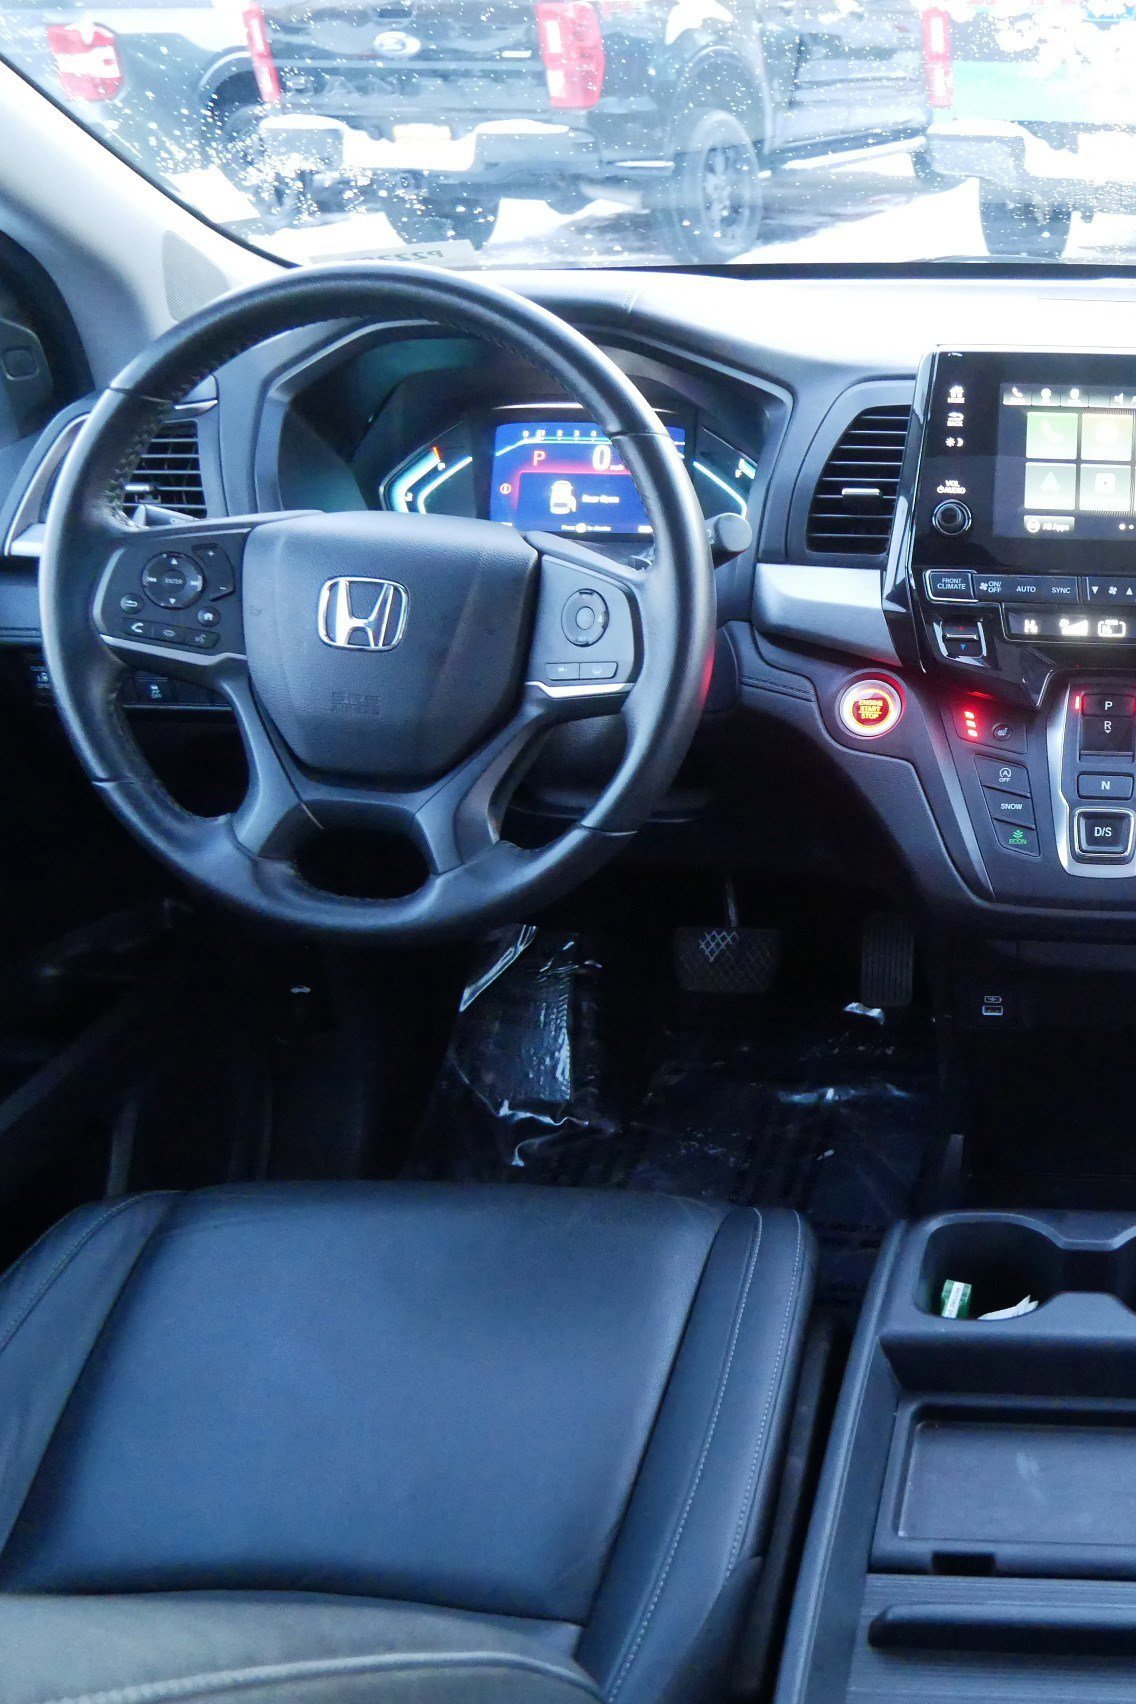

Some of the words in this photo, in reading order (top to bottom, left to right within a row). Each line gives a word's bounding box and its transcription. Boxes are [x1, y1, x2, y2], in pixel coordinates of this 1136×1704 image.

[532, 450, 546, 466] P
[592, 445, 611, 471] 0
[1104, 701, 1113, 711] P
[1104, 721, 1112, 731] R
[1101, 780, 1111, 790] N
[1094, 827, 1112, 837] D/S
